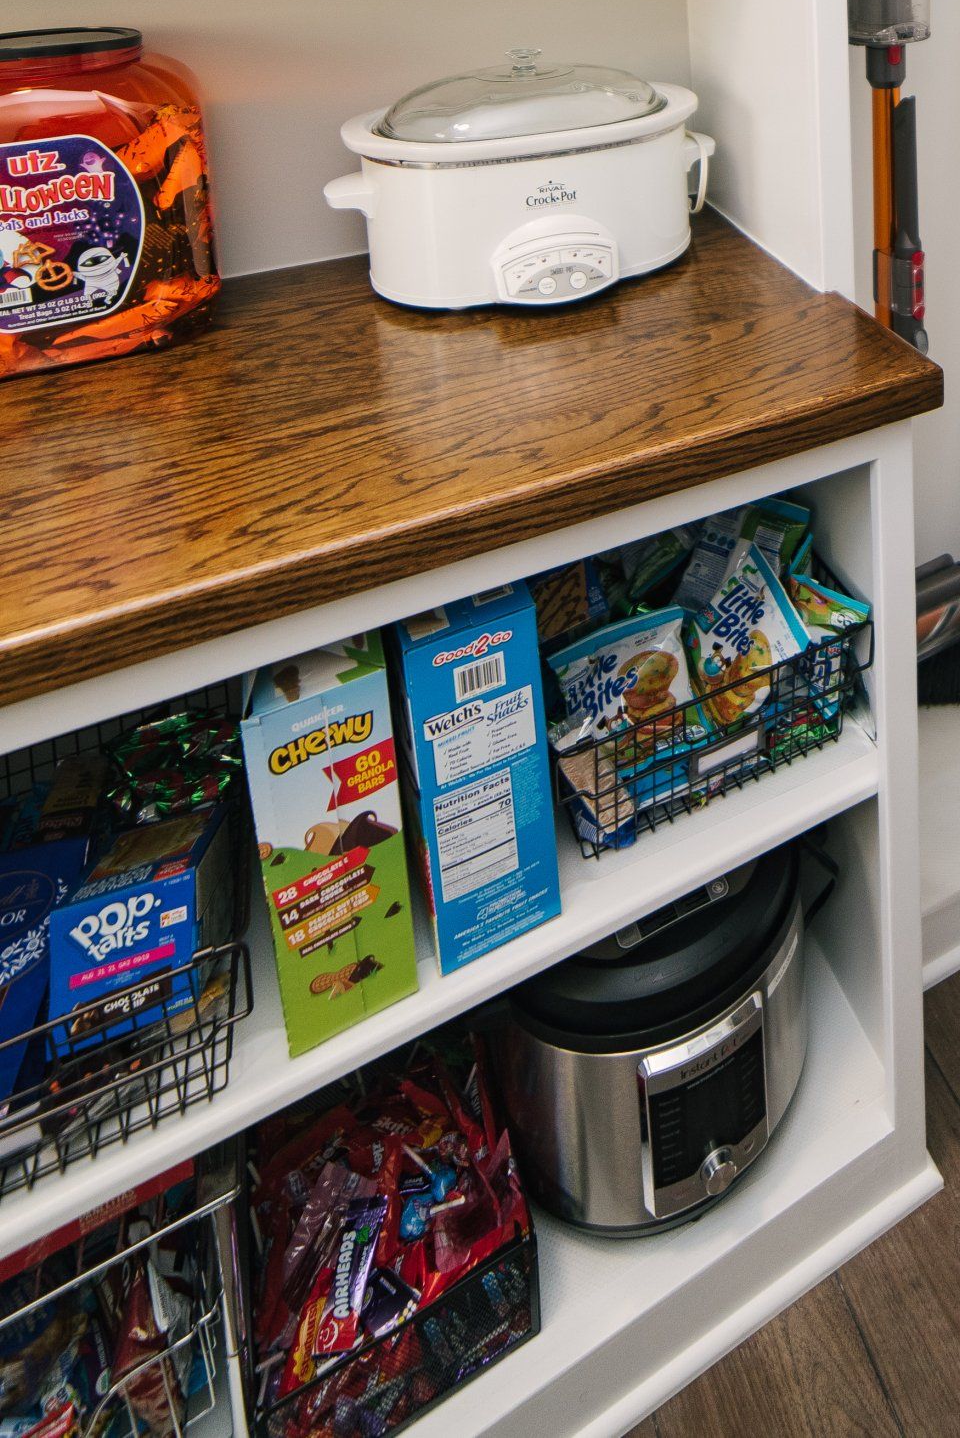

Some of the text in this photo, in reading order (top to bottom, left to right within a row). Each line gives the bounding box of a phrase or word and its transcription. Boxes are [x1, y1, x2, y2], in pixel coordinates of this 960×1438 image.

[540, 185, 565, 194] RIVAL
[26, 211, 51, 228] and
[54, 208, 89, 223] Jacks
[65, 297, 74, 305] LB
[36, 310, 53, 319] Bags
[717, 583, 765, 625] Little
[712, 612, 755, 656] Bites
[486, 698, 529, 727] Snacks
[494, 690, 523, 713] Fruit
[428, 703, 482, 736] Welch's
[355, 750, 381, 772] 60
[347, 760, 395, 787] GRANOLA
[358, 774, 385, 793] BARS
[435, 776, 510, 812] Nutrition Facts
[438, 798, 511, 835] Calories 70
[300, 868, 365, 909] DARK CHOCOLATE
[316, 873, 333, 886] CHIP
[278, 886, 298, 905] 28
[512, 900, 528, 912] FRUIT
[281, 909, 300, 926] 14
[87, 921, 151, 962] tarts
[288, 929, 306, 946] 18
[680, 1052, 718, 1081] Instant
[332, 1229, 357, 1320] AIRHEADS
